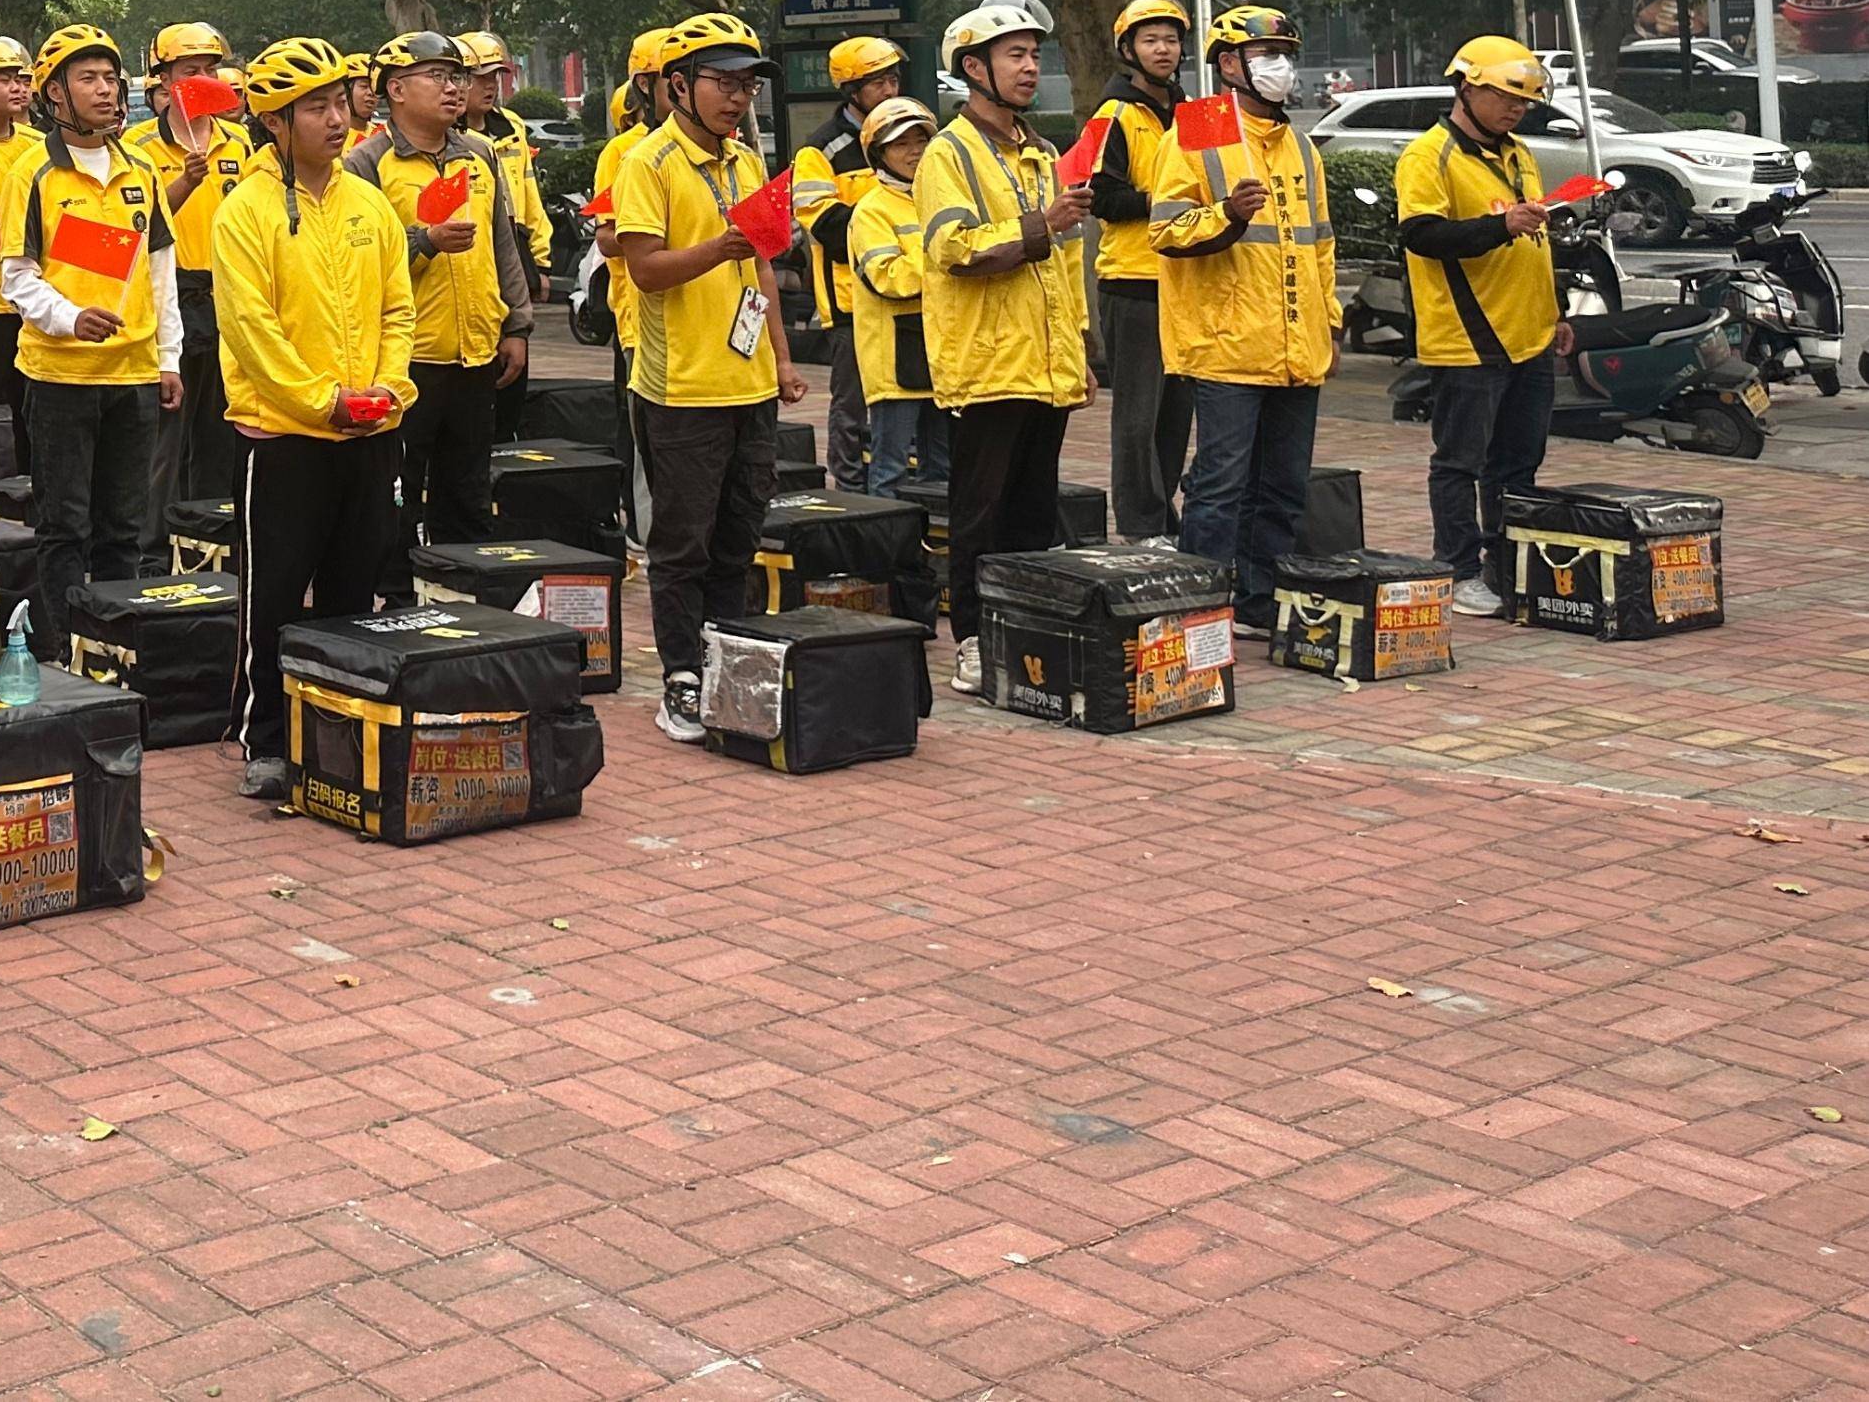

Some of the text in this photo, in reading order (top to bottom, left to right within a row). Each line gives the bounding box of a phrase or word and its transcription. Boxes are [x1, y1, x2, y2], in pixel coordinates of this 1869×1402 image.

[1537, 596, 1594, 618] 美团外卖
[1013, 683, 1063, 711] 美团外卖
[414, 744, 501, 771] 岗位:送餐员
[307, 777, 361, 815] 扫码报名
